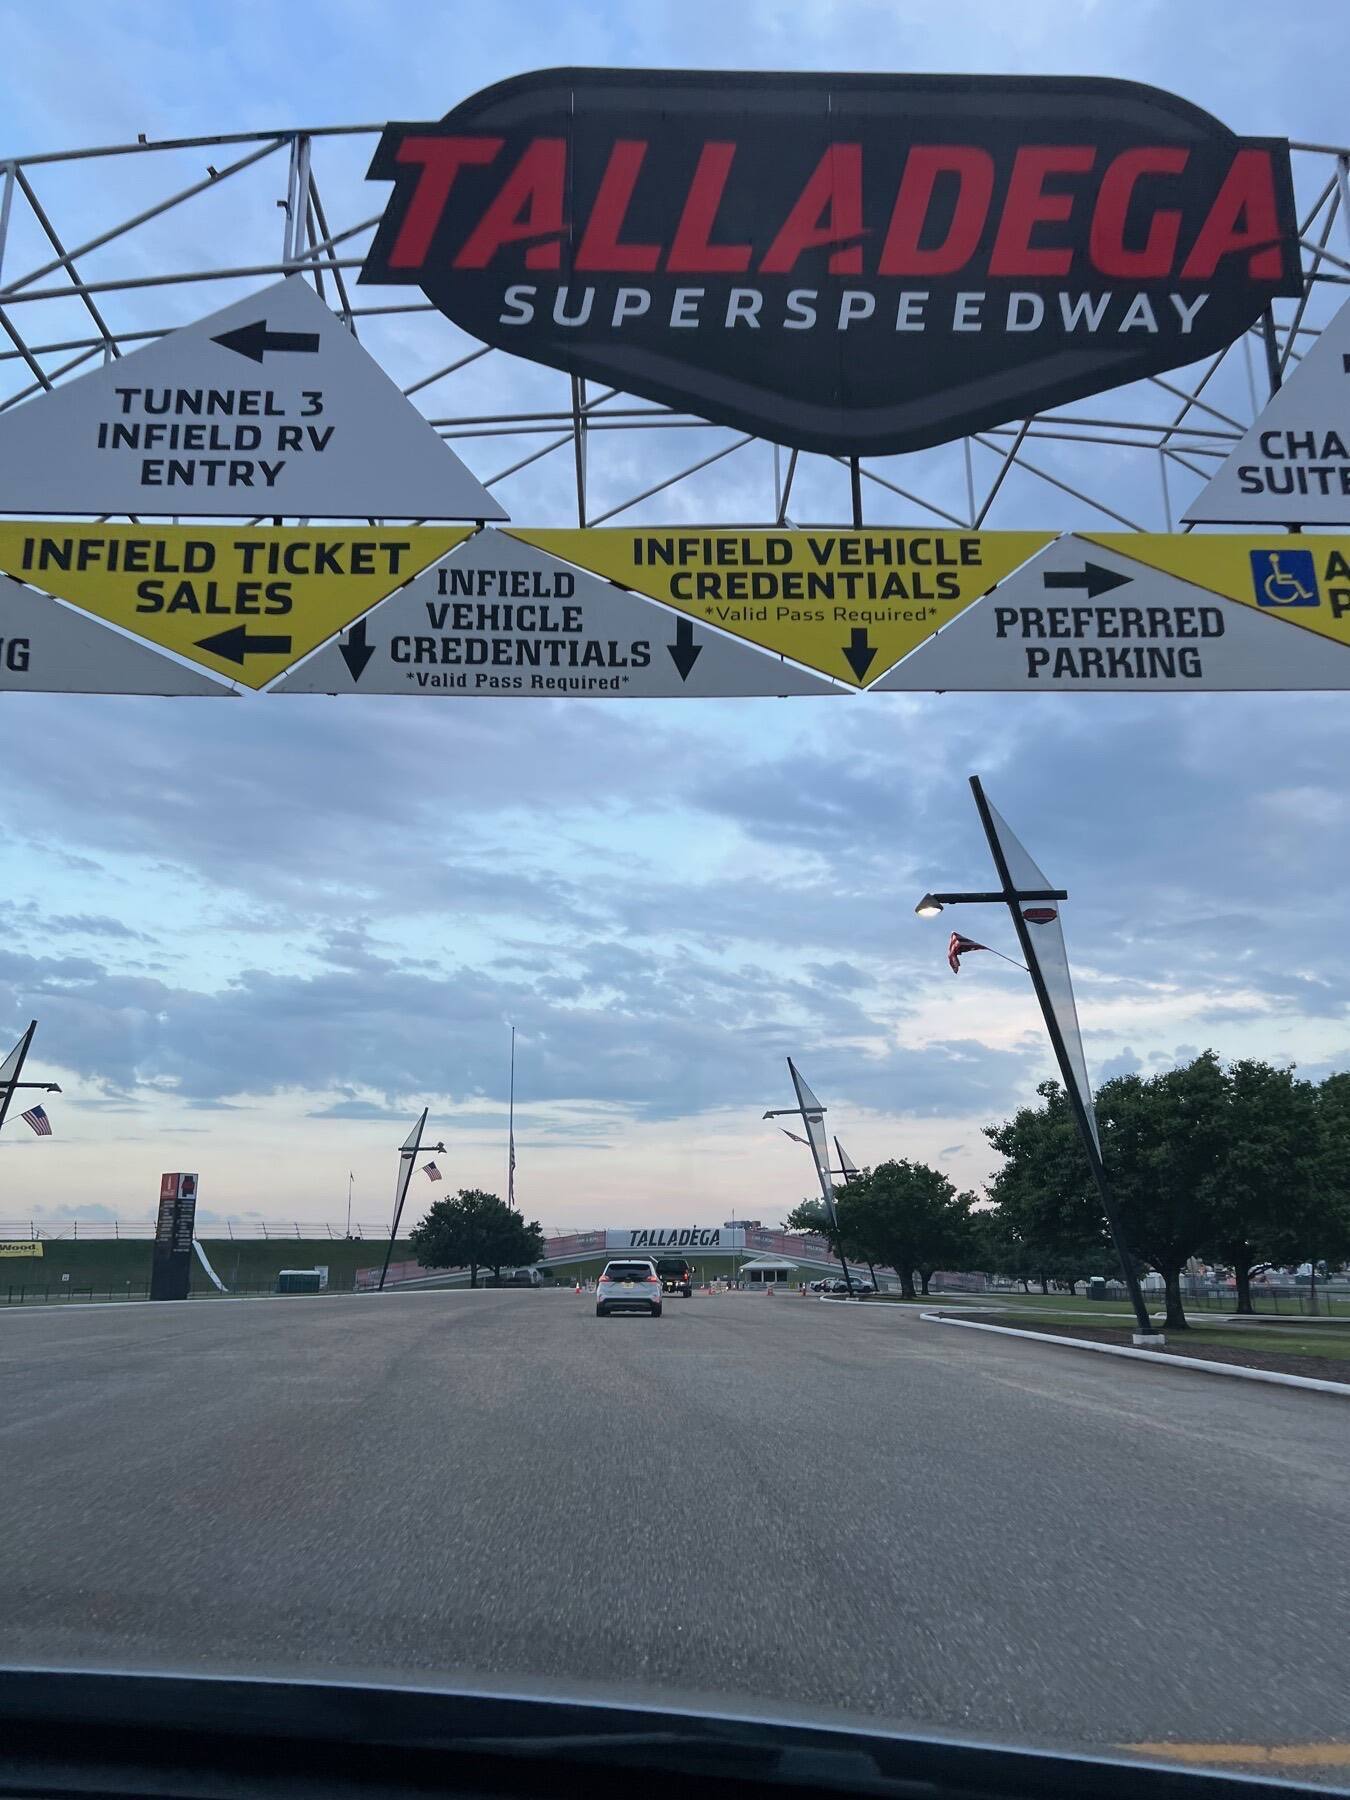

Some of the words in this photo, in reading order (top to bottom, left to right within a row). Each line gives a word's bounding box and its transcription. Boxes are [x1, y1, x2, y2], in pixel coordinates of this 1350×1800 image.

[389, 138, 1282, 279] TALLADEGA
[499, 284, 1210, 334] SUPERSPEEDWAY
[114, 388, 286, 417] TUNNEL
[300, 391, 324, 417] 3
[97, 422, 262, 451] INFIELD
[277, 425, 335, 452] RV
[1259, 430, 1350, 460] CHA
[140, 459, 286, 487] ENTRY
[21, 537, 216, 574] INFIELD
[232, 540, 412, 576] TICKET
[633, 538, 793, 566] INFIELD
[807, 537, 983, 566] VEHICLE
[135, 579, 293, 615] SALES
[437, 568, 575, 599] INFIELD
[669, 571, 961, 601] CREDENTIALS
[425, 602, 583, 633] VEHICLE
[776, 606, 825, 622] Pass
[994, 607, 1225, 639] PREFERRED
[0, 637, 30, 672] G
[390, 636, 651, 668] CREDENTIALS
[1025, 646, 1203, 679] PARKING
[475, 673, 523, 689] Pass
[630, 1229, 720, 1247] TALLADEGA
